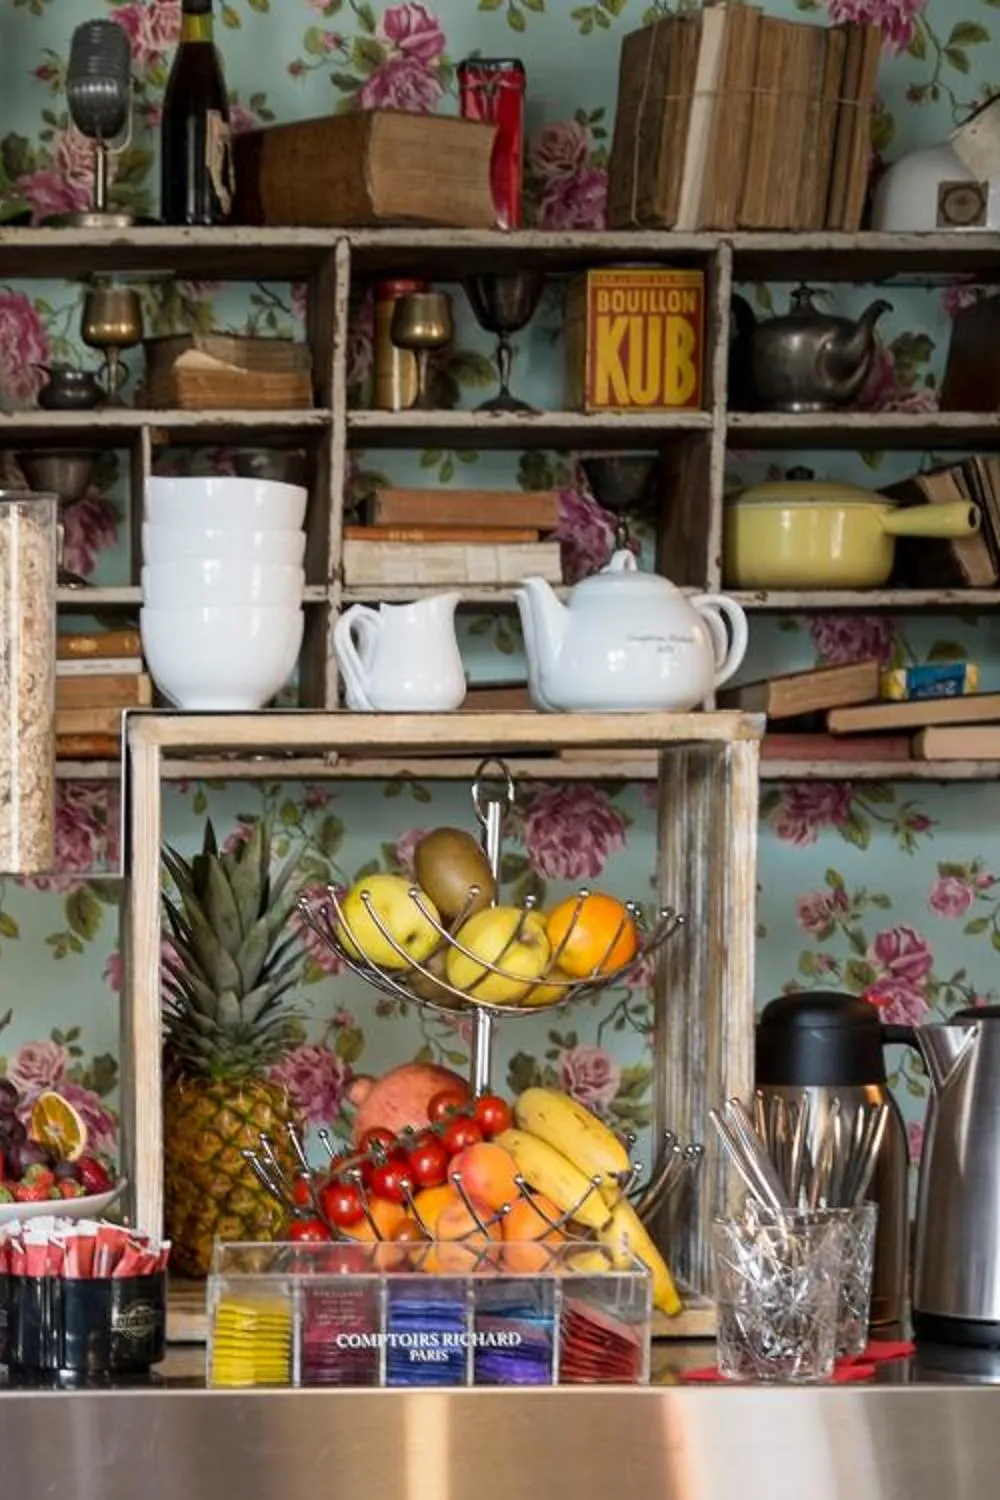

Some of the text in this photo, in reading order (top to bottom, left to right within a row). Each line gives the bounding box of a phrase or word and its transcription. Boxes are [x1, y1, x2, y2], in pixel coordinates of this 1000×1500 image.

[597, 289, 697, 313] BOUILLON
[595, 315, 697, 405] KUB
[336, 1331, 522, 1348] COMPTOIRS RICHARD
[409, 1350, 449, 1362] PARIS
